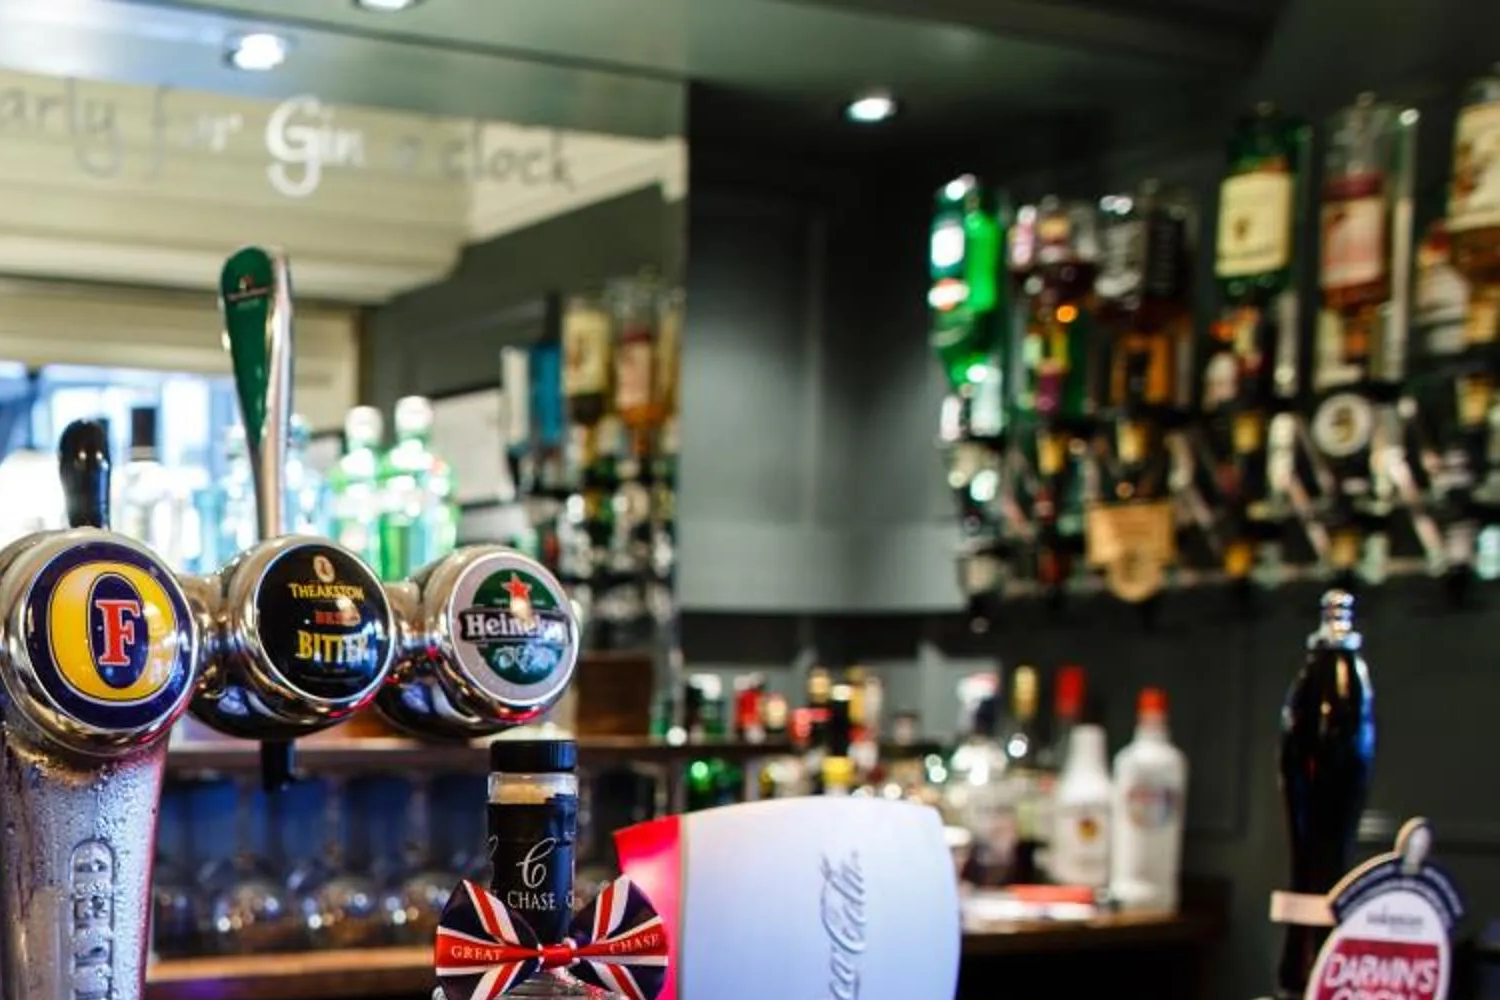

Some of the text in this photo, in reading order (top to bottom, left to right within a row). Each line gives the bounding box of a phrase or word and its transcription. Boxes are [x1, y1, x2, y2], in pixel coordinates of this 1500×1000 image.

[265, 94, 367, 197] Gin
[388, 118, 576, 192] oclock
[287, 582, 365, 600] THEAKSTON
[95, 599, 141, 666] F
[465, 612, 563, 642] Heinek
[295, 630, 370, 665] BITTER
[507, 889, 556, 911] CHASE
[451, 933, 660, 962] GREAT CHASE
[1323, 952, 1438, 993] DARWIN'S
